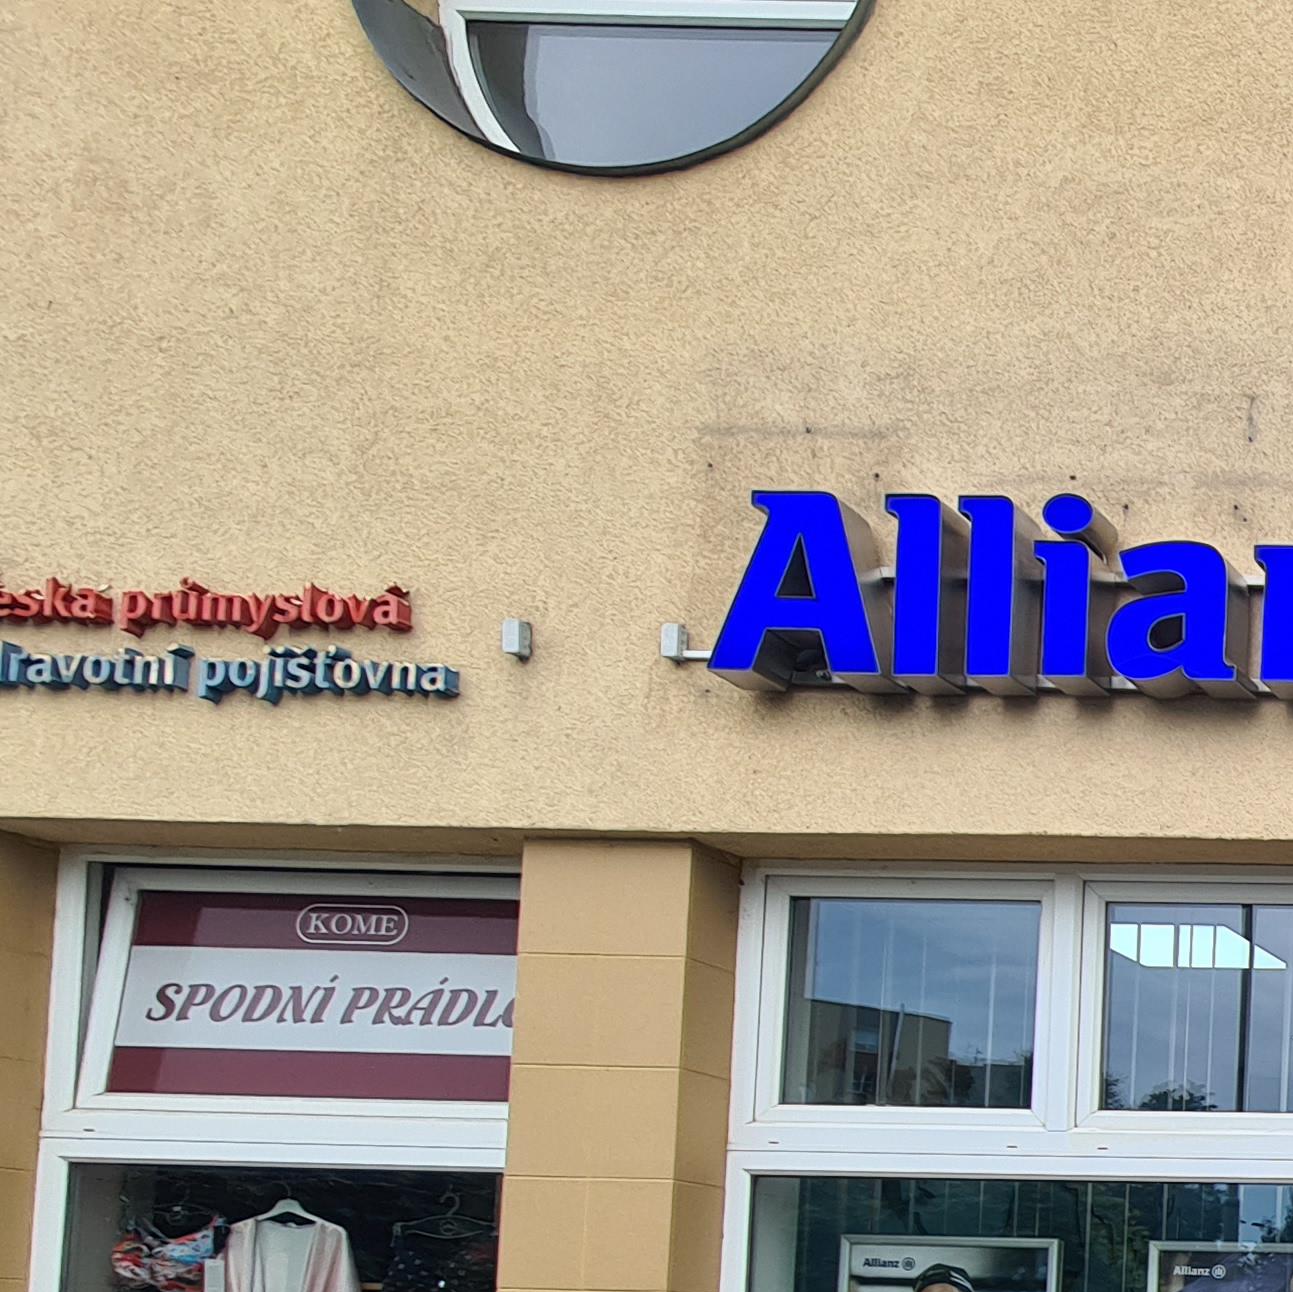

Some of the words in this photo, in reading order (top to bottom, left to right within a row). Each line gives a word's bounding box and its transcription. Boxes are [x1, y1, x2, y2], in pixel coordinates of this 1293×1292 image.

[119, 576, 413, 640] průmyslová
[198, 645, 461, 705] pojišťovna
[306, 912, 399, 937] KOME
[145, 974, 340, 1024] SPODNÍ
[863, 1258, 900, 1269] Allianz
[1173, 1265, 1210, 1276] Allianz
